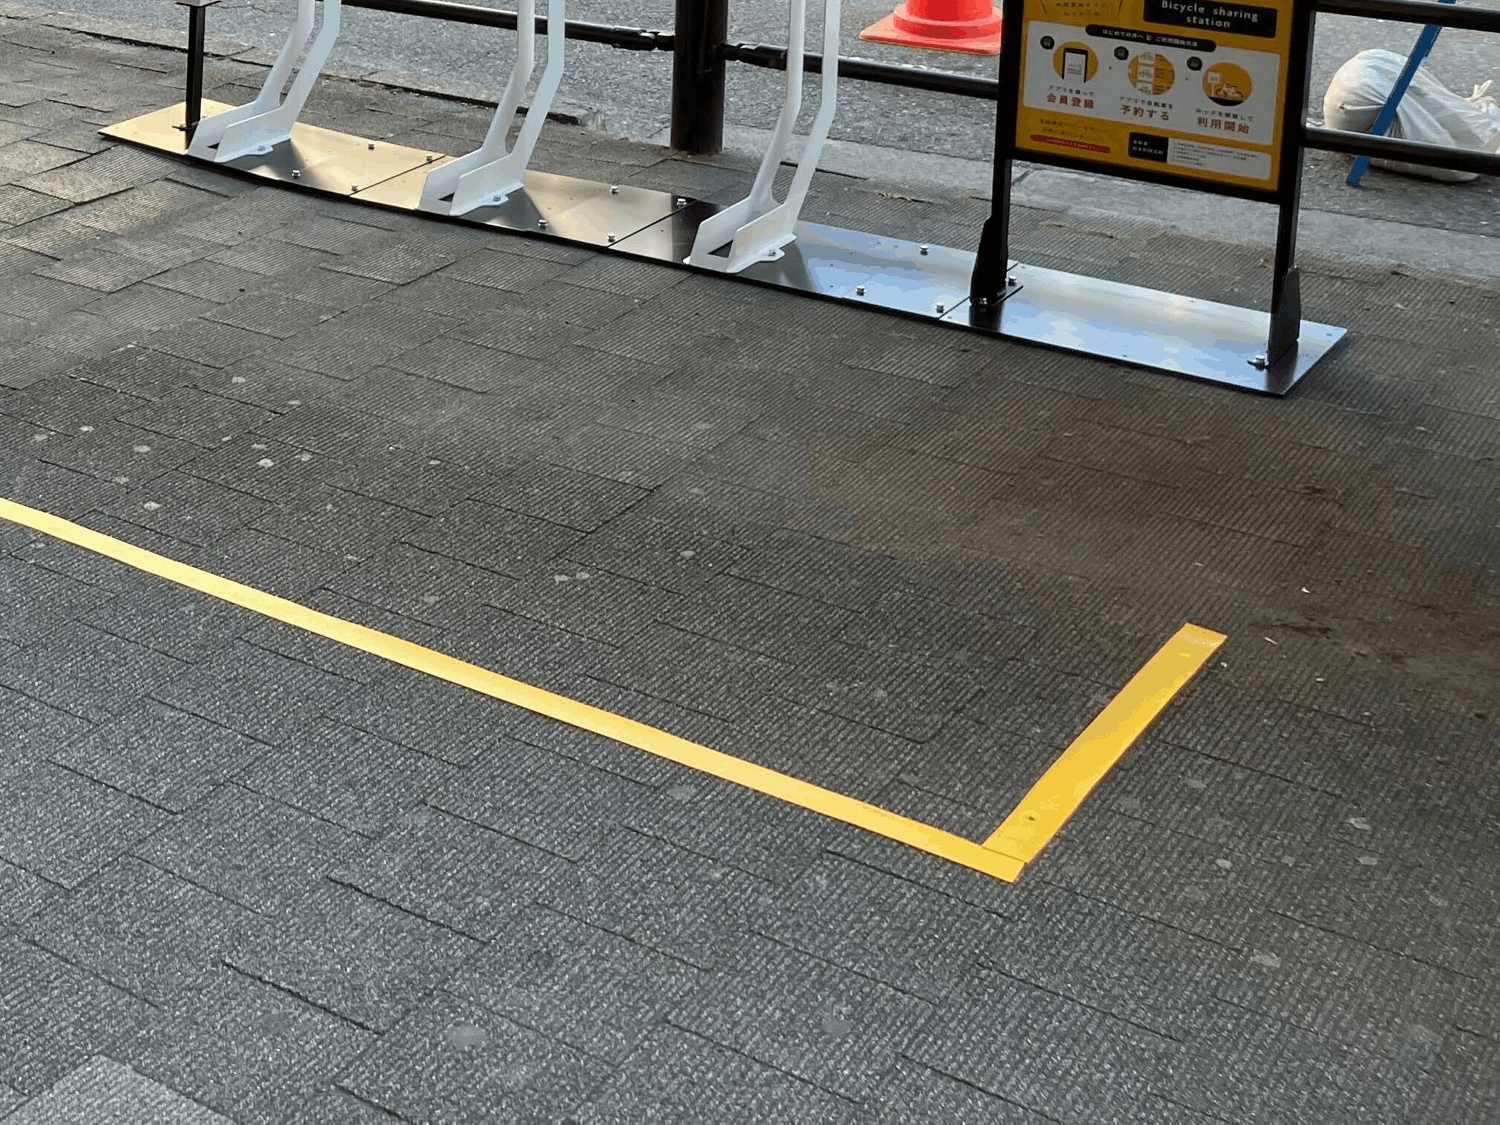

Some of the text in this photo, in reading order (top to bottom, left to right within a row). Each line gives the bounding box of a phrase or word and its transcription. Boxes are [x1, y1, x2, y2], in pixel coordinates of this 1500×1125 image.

[1161, 0, 1259, 23] Bicycle sharing
[1186, 15, 1231, 28] station
[1046, 93, 1095, 109] 会員登録
[1120, 104, 1169, 121] 予約する
[1197, 116, 1250, 134] 利用開始
